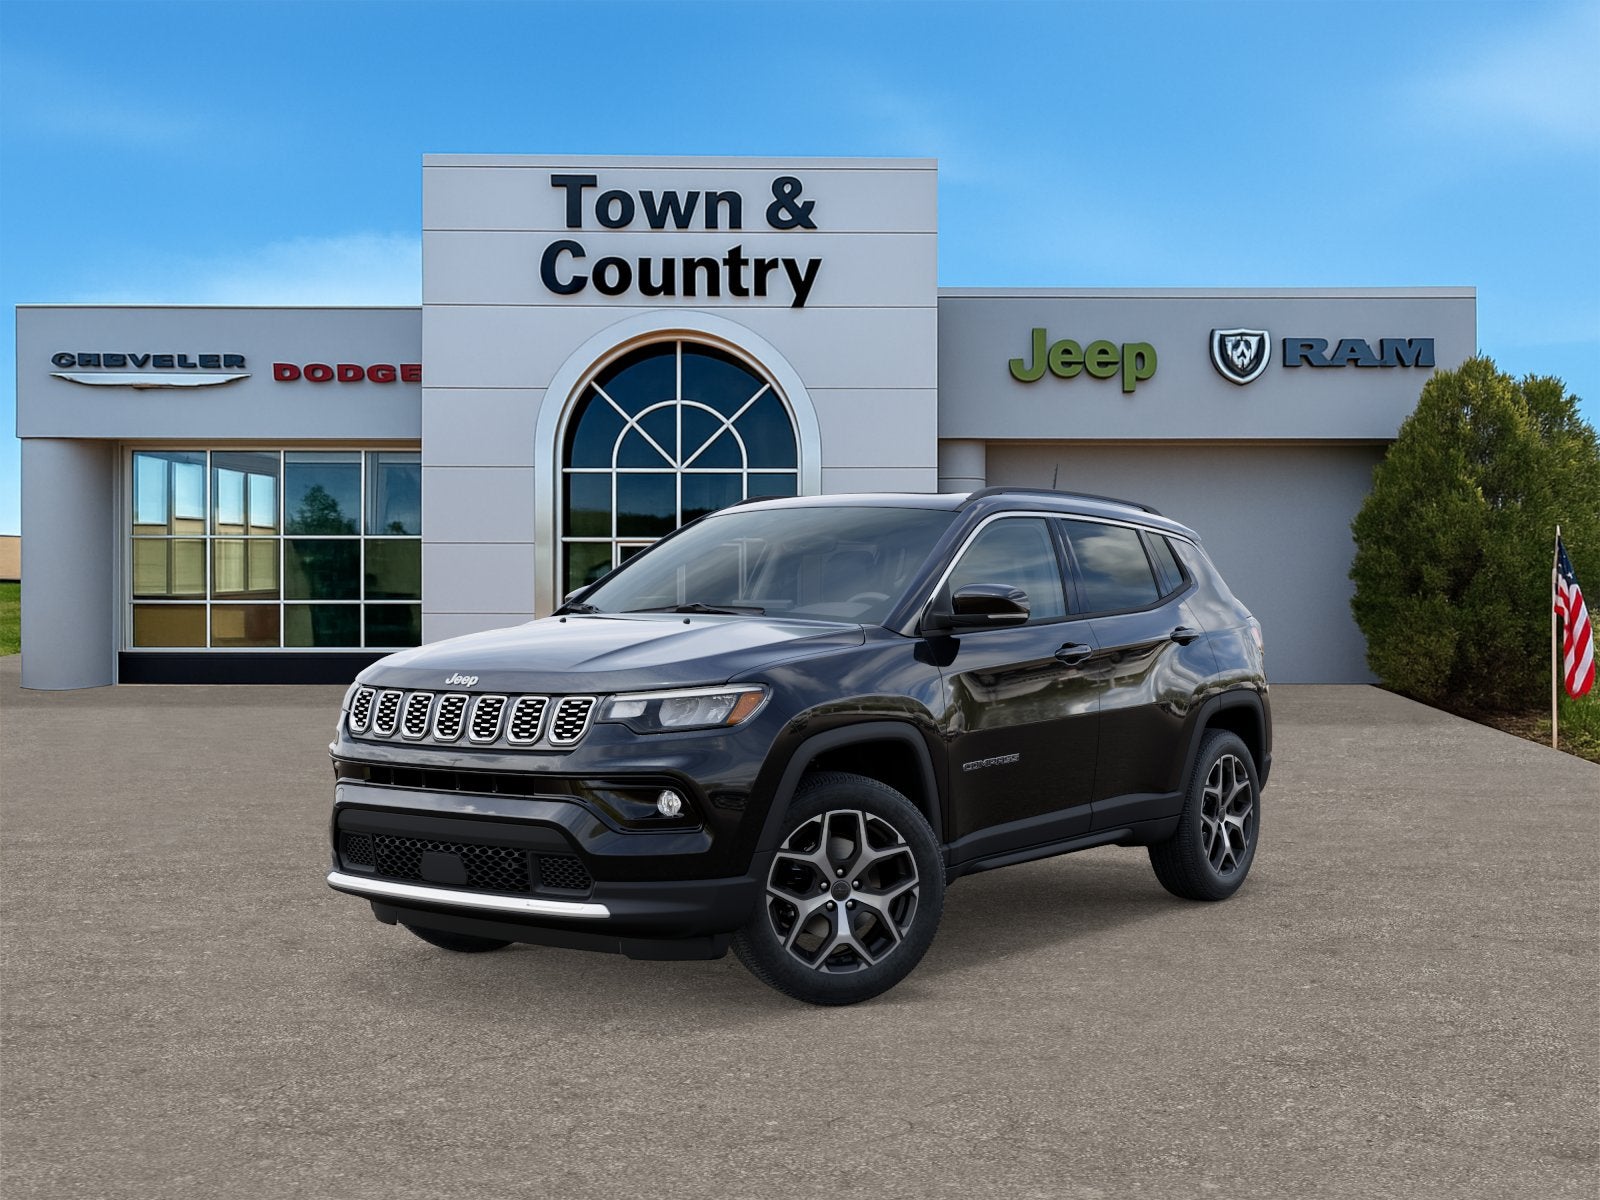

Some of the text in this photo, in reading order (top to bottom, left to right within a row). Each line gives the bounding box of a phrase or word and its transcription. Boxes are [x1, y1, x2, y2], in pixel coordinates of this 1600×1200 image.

[551, 174, 818, 230] Town &
[540, 239, 822, 308] Country
[273, 363, 422, 382] DODGE
[1009, 328, 1158, 393] Jeep
[1283, 337, 1436, 367] RAM
[445, 673, 479, 688] Jeep
